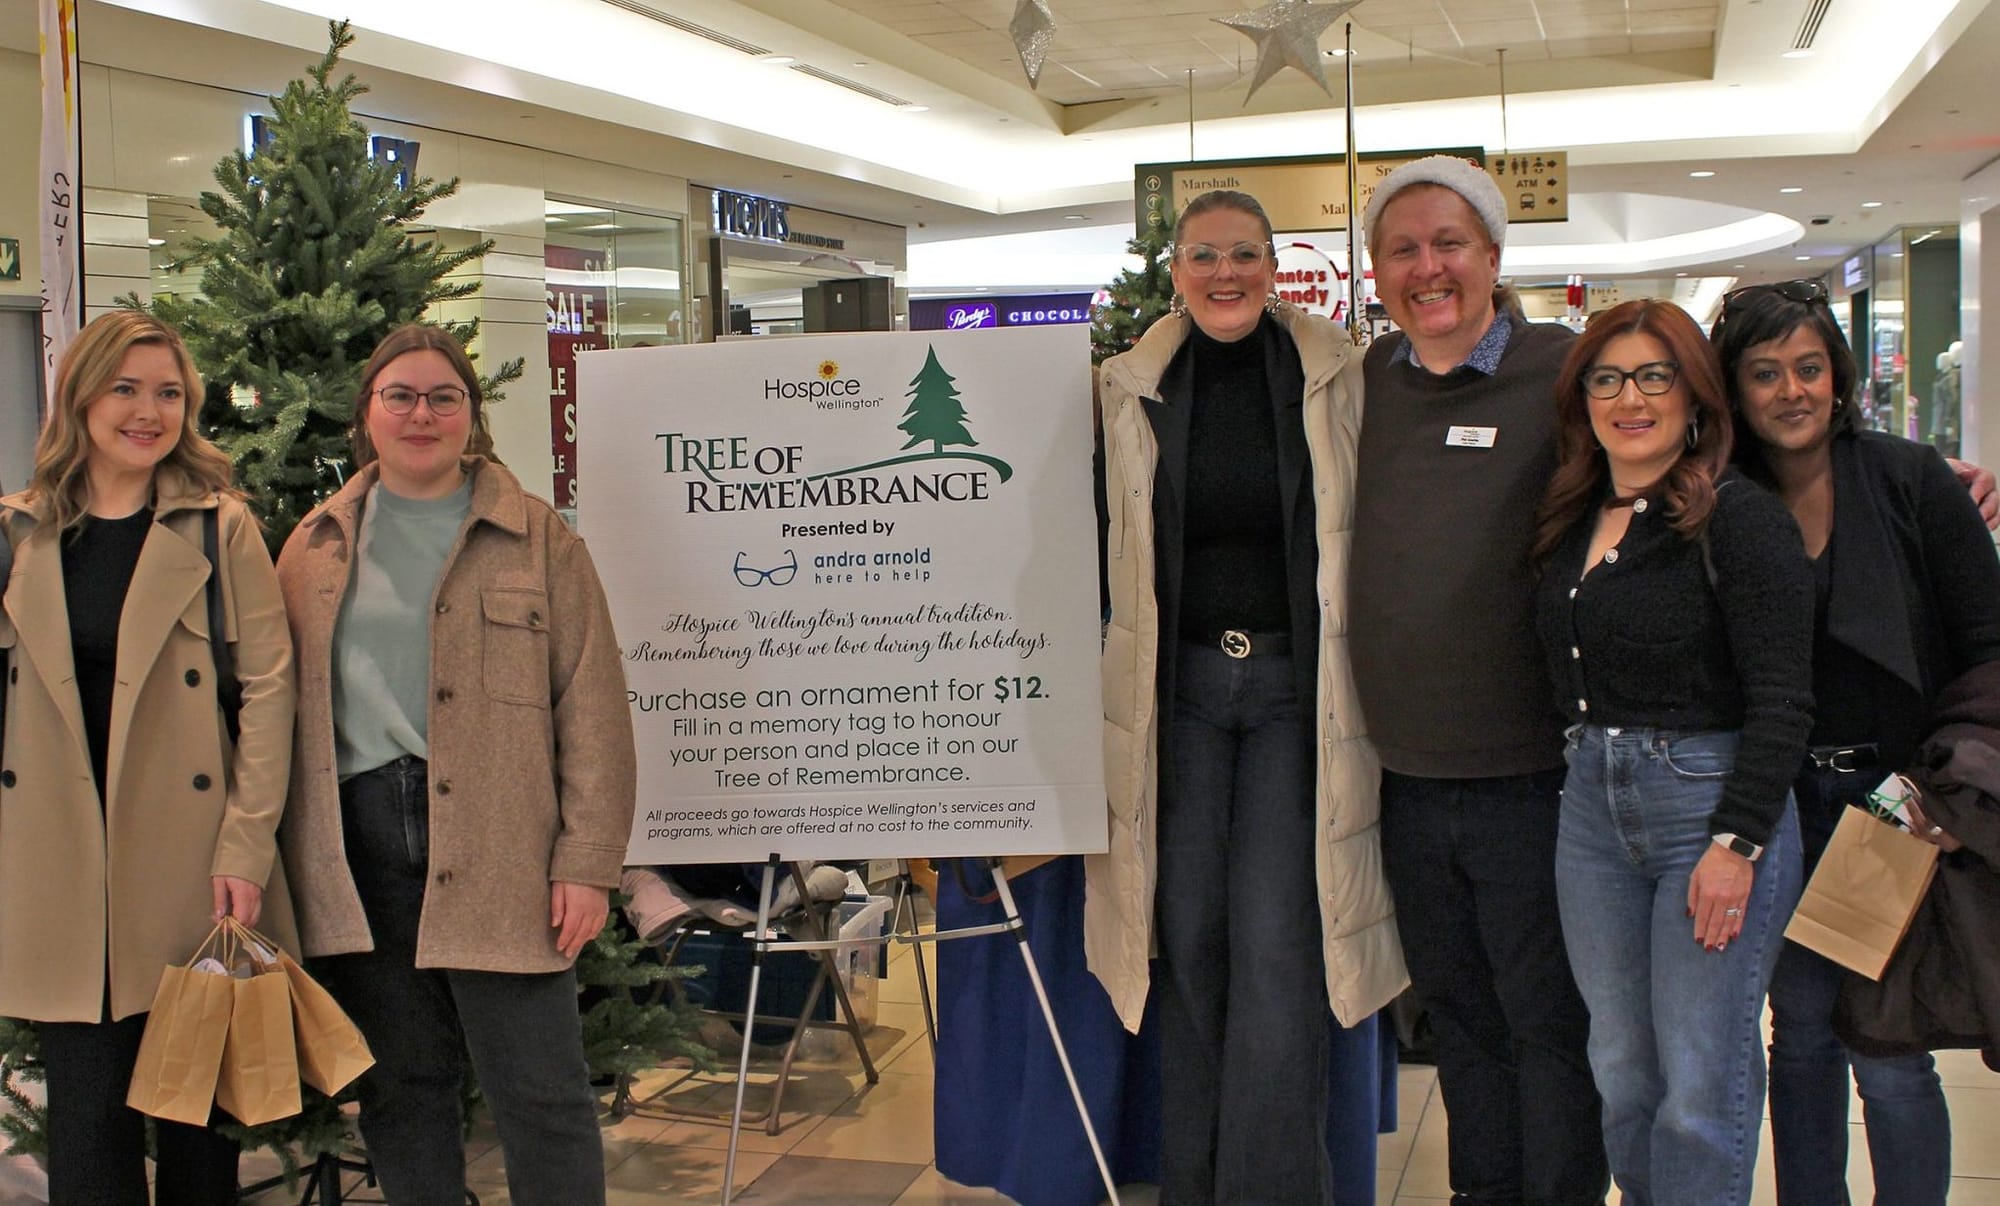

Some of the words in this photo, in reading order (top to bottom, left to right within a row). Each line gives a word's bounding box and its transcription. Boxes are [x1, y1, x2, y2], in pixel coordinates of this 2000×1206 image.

[1182, 177, 1240, 189] Marshalls
[1516, 179, 1538, 188] ATM
[1321, 203, 1346, 216] Mal
[1275, 269, 1327, 283] anta's
[1279, 285, 1329, 306] andy
[545, 290, 595, 333] SALE
[764, 378, 861, 402] Hospice
[655, 432, 749, 481] TREE
[753, 446, 803, 475] OF
[686, 471, 989, 514] REMEMBRANCE
[782, 520, 867, 538] Presented
[873, 519, 895, 537] by
[814, 549, 866, 568] andra
[873, 548, 931, 566] arnold
[815, 572, 853, 585] here
[865, 571, 880, 583] to
[893, 569, 931, 584] help
[662, 613, 740, 643] Hospice
[745, 608, 855, 639] Wellington's
[860, 605, 925, 626] annual
[927, 602, 1012, 624] tradition.
[625, 640, 752, 670] Remembering
[758, 637, 802, 659] those
[807, 641, 830, 656] we
[834, 634, 870, 654] love
[873, 633, 931, 662] during
[937, 631, 967, 650] the
[969, 628, 1051, 659] holidays.
[627, 688, 746, 712] Purchase
[756, 690, 791, 708] an
[801, 679, 939, 706] ornament
[947, 678, 985, 701] for
[994, 675, 1049, 703] $12.
[673, 718, 697, 736] Fill
[704, 717, 721, 736] in
[728, 720, 742, 735] a
[750, 717, 841, 736] memory
[848, 712, 886, 735] tag
[893, 712, 915, 729] to
[922, 710, 1002, 729] honour
[670, 747, 717, 767] your
[724, 745, 797, 765] person
[804, 739, 849, 759] and
[857, 738, 920, 761] place
[927, 737, 940, 755] it
[946, 739, 975, 755] on
[982, 738, 1019, 754] our
[715, 769, 760, 787] Tree
[768, 767, 789, 786] of
[796, 765, 970, 786] Remembrance.
[646, 809, 662, 822] All
[664, 808, 728, 823] proceeds
[731, 809, 749, 822] go
[753, 806, 806, 819] towards
[809, 804, 863, 819] Hospice
[867, 802, 948, 817] Wellington's
[951, 800, 1004, 814] services
[1007, 799, 1036, 813] and
[648, 826, 713, 840] programs,
[718, 823, 757, 837] which
[760, 826, 782, 836] are
[786, 822, 835, 834] offered
[839, 821, 853, 833] at
[857, 821, 875, 833] no
[878, 820, 907, 832] cost
[910, 819, 924, 831] to
[928, 818, 950, 831] the
[953, 816, 1033, 831] community.
